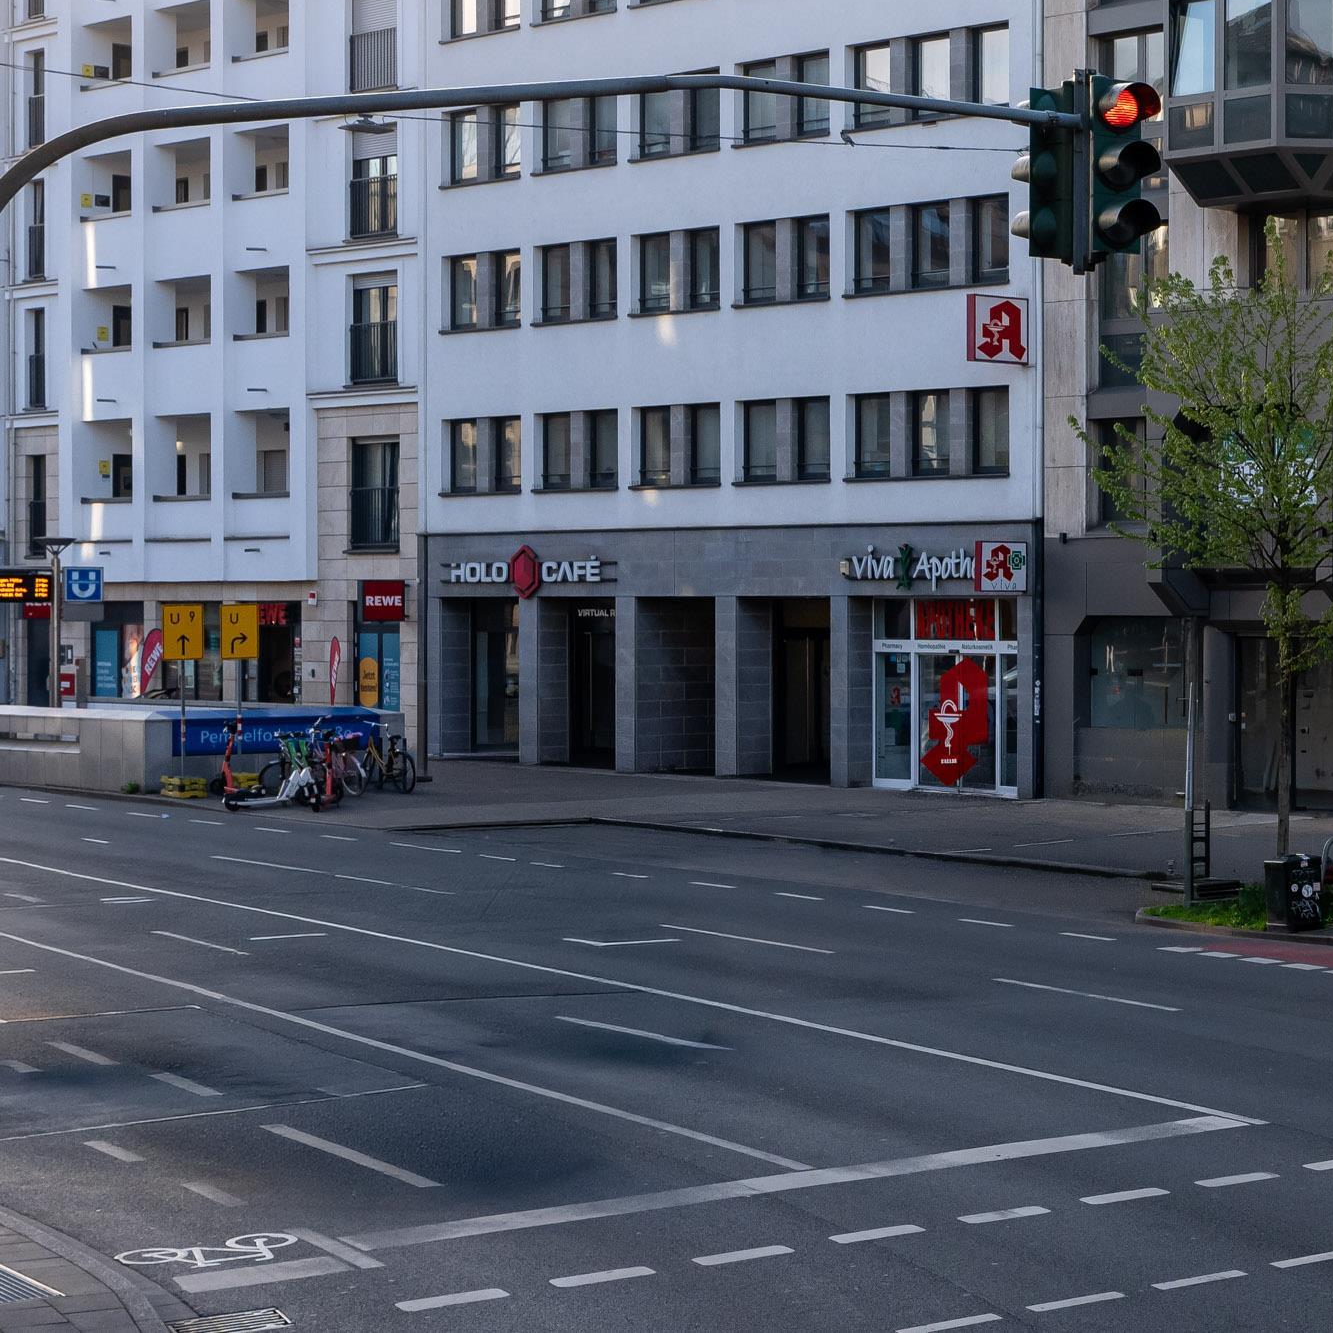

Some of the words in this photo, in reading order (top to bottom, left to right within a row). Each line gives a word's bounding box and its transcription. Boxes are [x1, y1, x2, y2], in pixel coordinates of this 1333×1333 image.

[851, 543, 895, 580] viva
[450, 561, 509, 583] HOLO
[541, 554, 601, 583] CAFÉ
[71, 570, 97, 598] U
[991, 580, 1017, 590] viva
[365, 595, 403, 607] REWE
[169, 612, 180, 625] U
[229, 612, 239, 624] U
[258, 603, 287, 625] EWE
[577, 608, 609, 617] VIRTUAL
[881, 643, 903, 651] Pharmacy
[961, 643, 993, 651] Naturkosmetik
[144, 642, 163, 676] REWE
